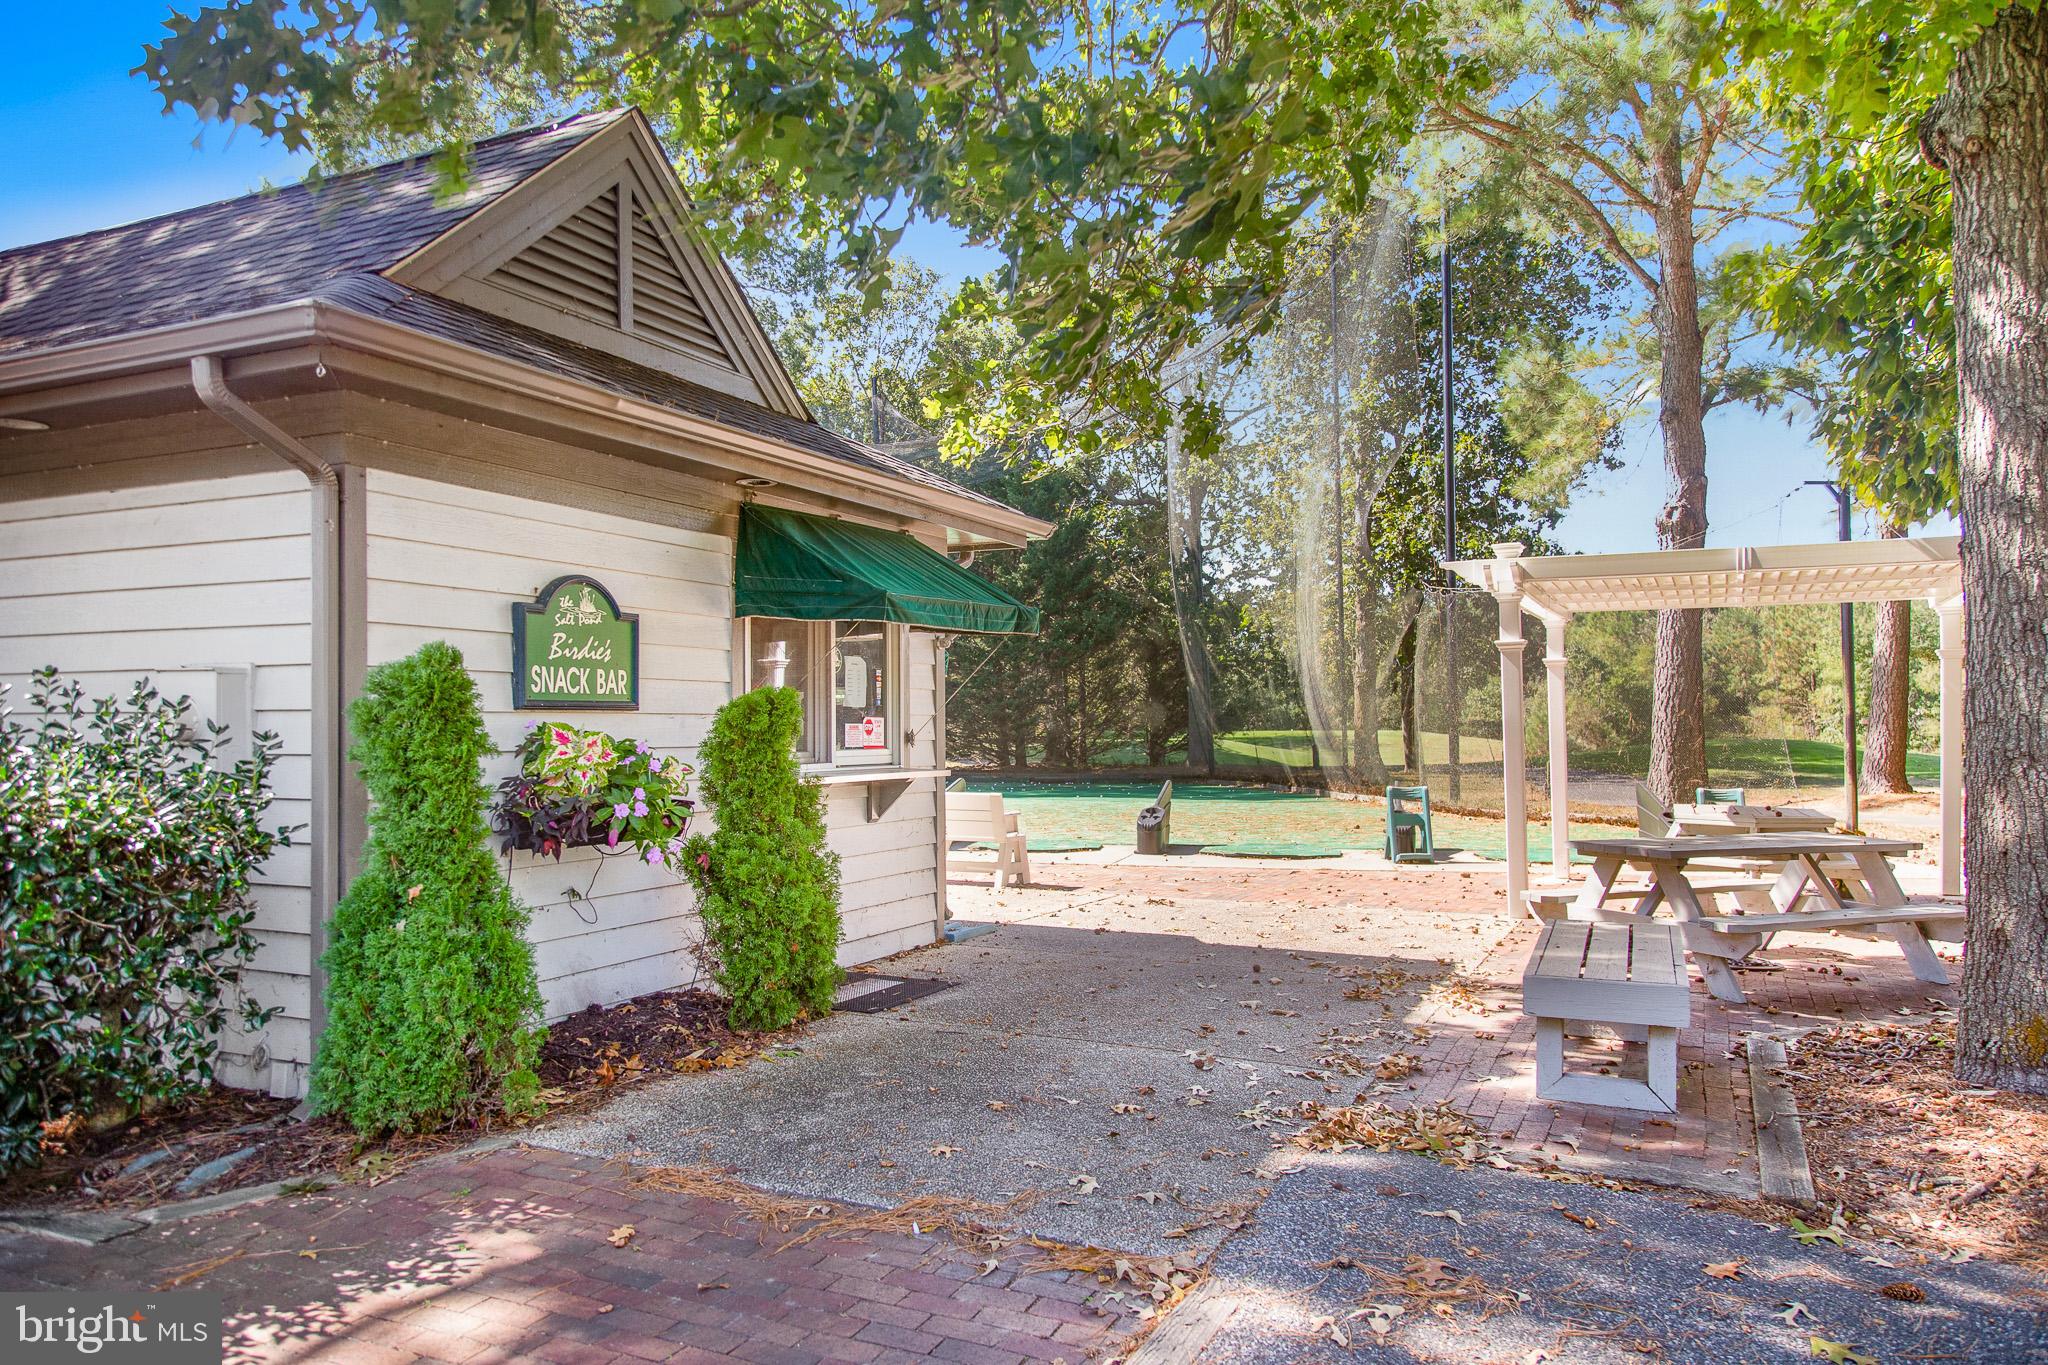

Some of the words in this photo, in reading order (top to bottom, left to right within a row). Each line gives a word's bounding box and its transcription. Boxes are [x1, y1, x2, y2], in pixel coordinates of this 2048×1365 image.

[555, 613, 575, 626] Salt
[578, 613, 602, 626] Pond
[548, 632, 611, 662] Birdie's
[531, 665, 590, 694] SNACK
[596, 668, 627, 695] BAR
